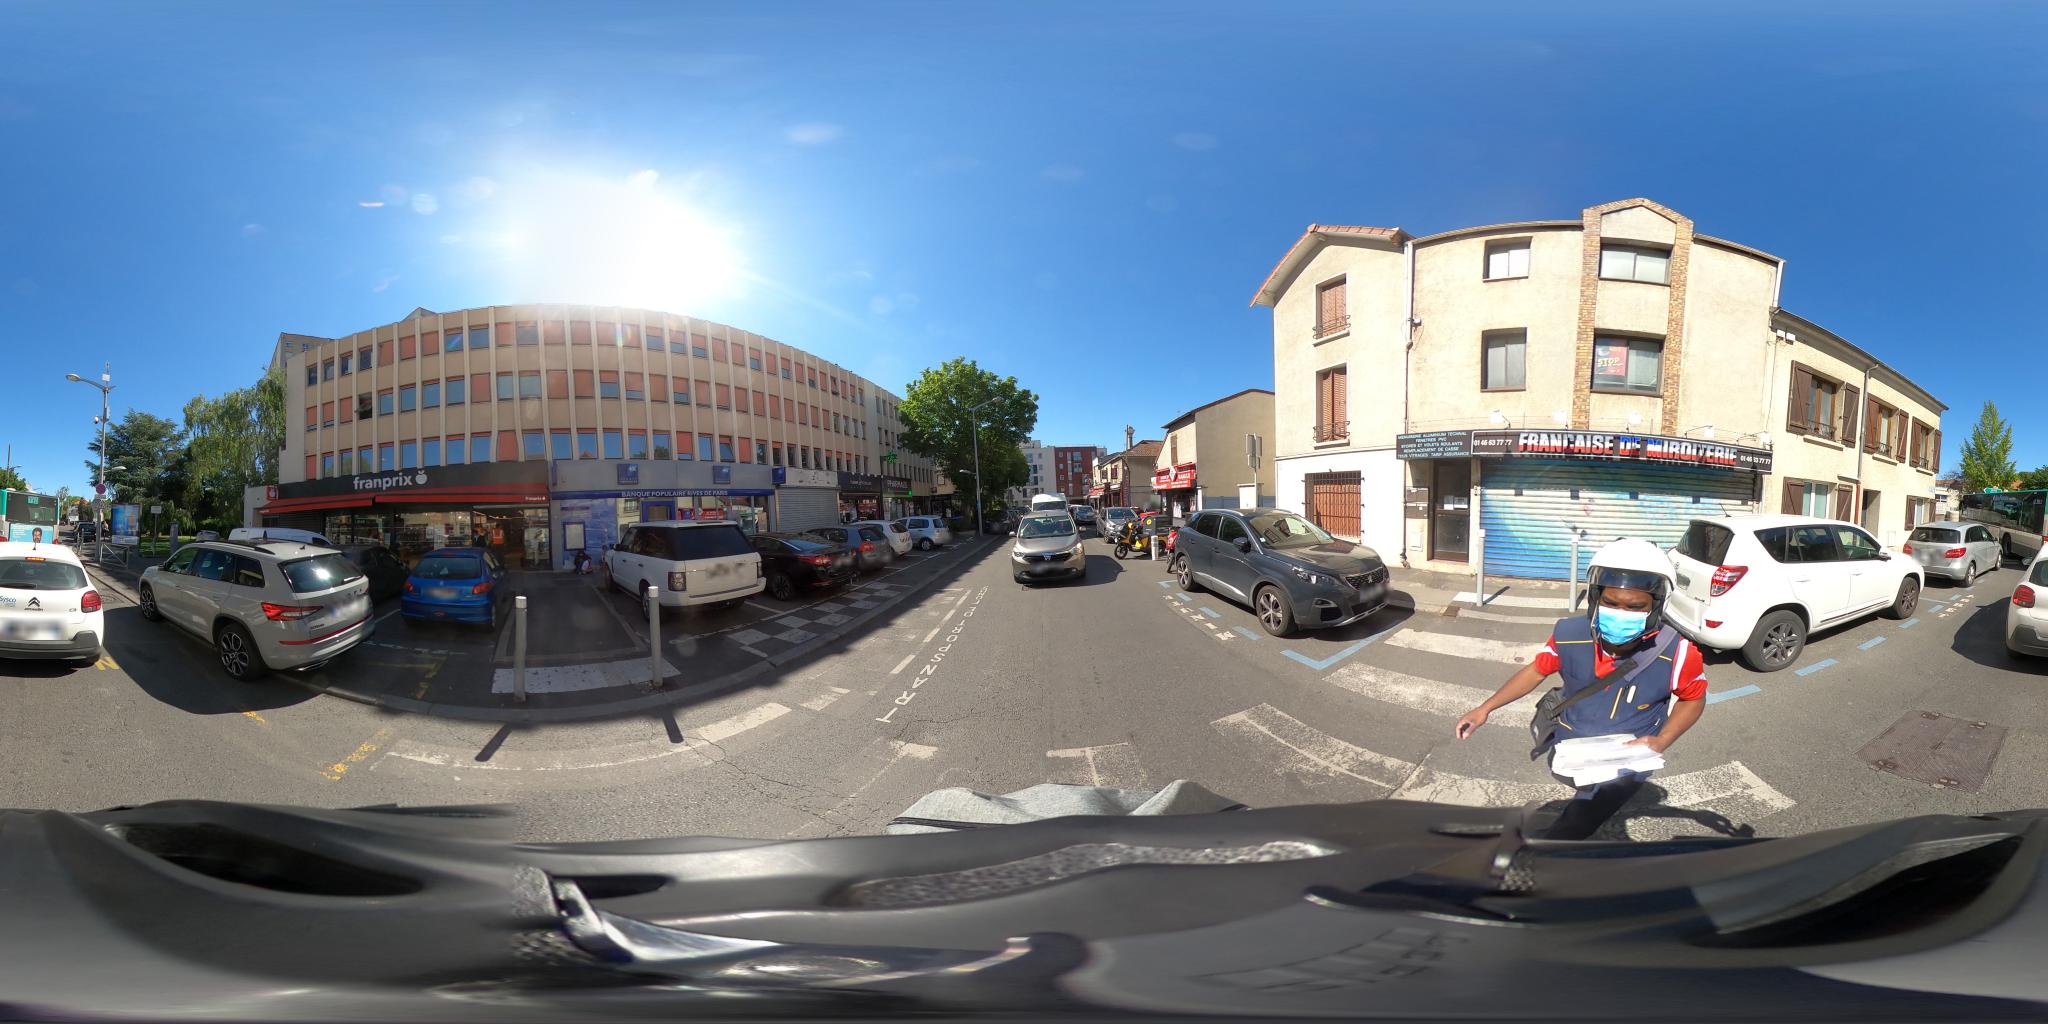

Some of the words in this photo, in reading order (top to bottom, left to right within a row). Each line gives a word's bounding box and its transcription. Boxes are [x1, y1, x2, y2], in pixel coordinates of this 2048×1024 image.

[1619, 436, 1642, 457] DE
[1646, 438, 1738, 466] MIROITERIE
[353, 472, 412, 490] franprix
[876, 619, 966, 723] TRANSPORT
